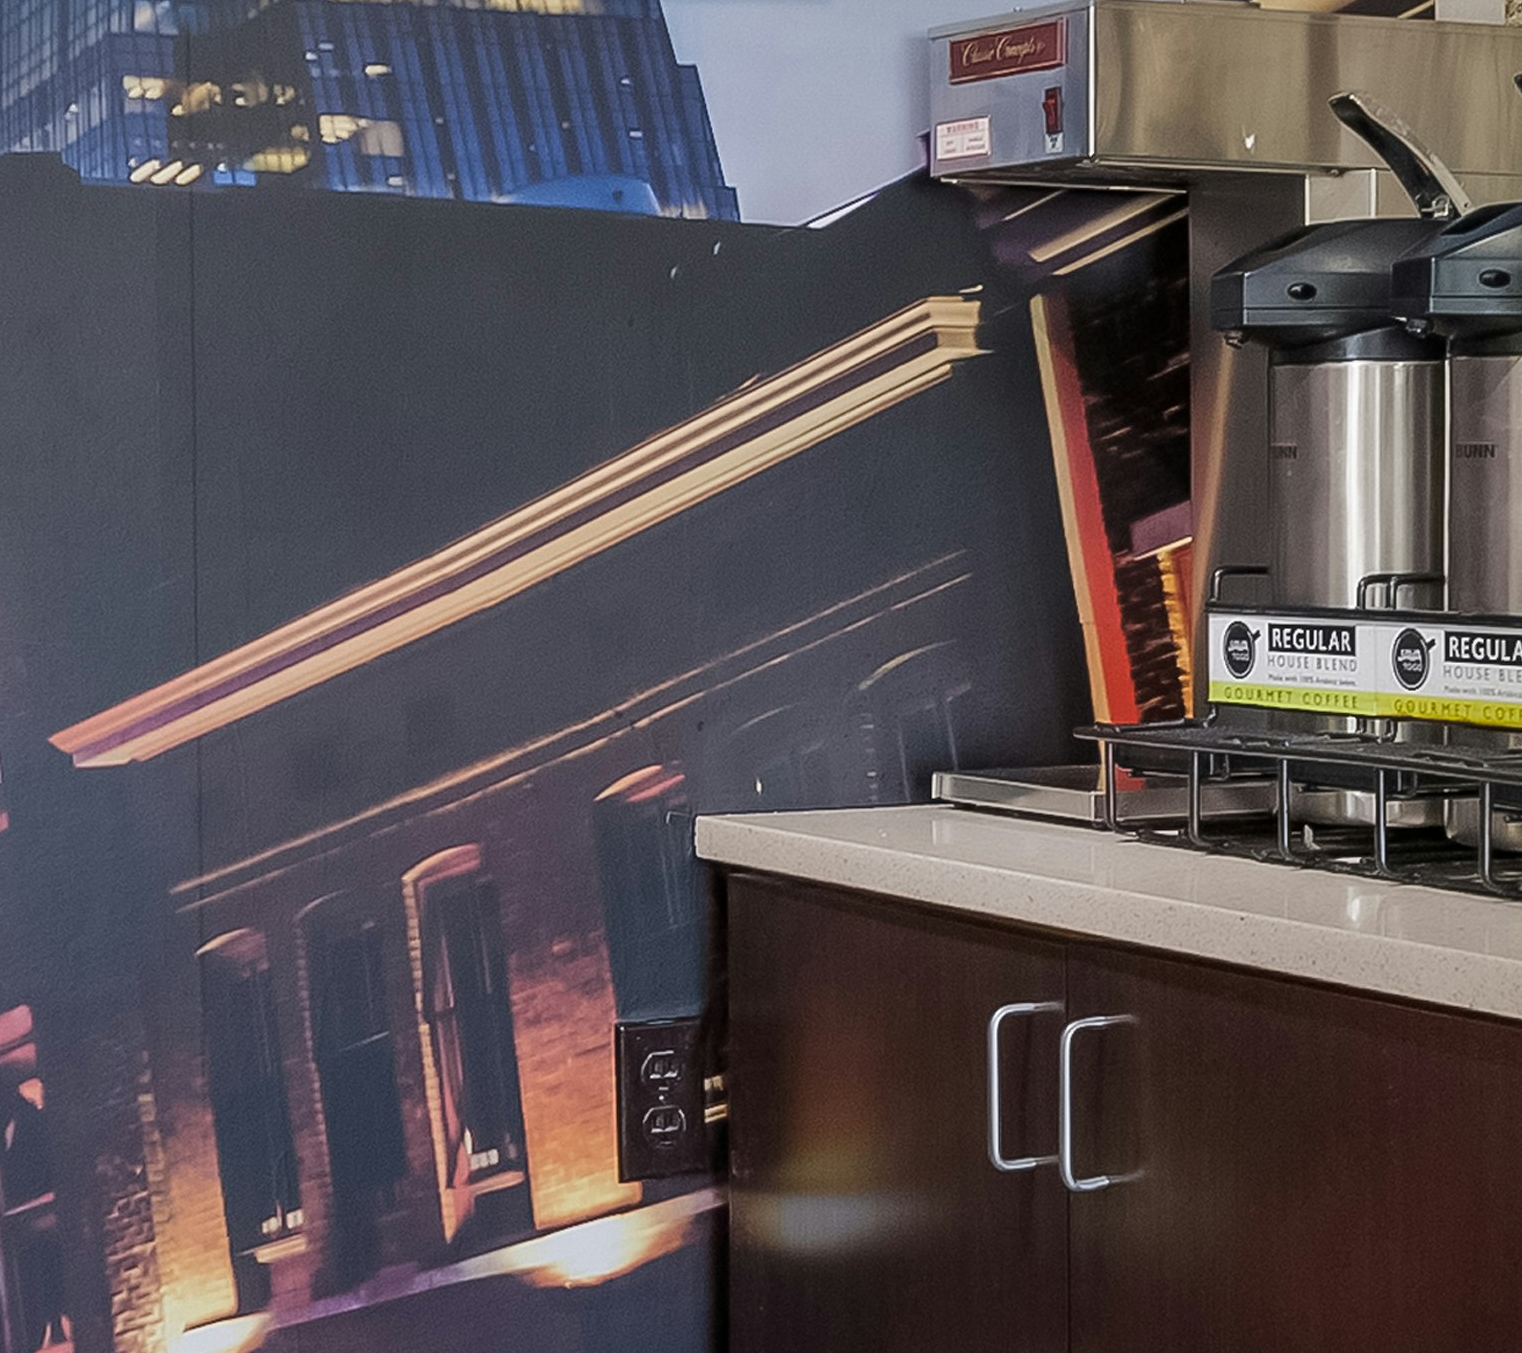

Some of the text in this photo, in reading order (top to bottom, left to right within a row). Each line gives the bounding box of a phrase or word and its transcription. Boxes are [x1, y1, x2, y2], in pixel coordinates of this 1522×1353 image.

[1456, 444, 1495, 458] BUNN
[1272, 628, 1352, 652] REGULAR
[1268, 654, 1358, 672] HOUSE BLEND
[1443, 666, 1491, 681] HOUSE
[1224, 687, 1358, 708] GOURMET COFFEE
[1394, 699, 1472, 719] GOURMET
